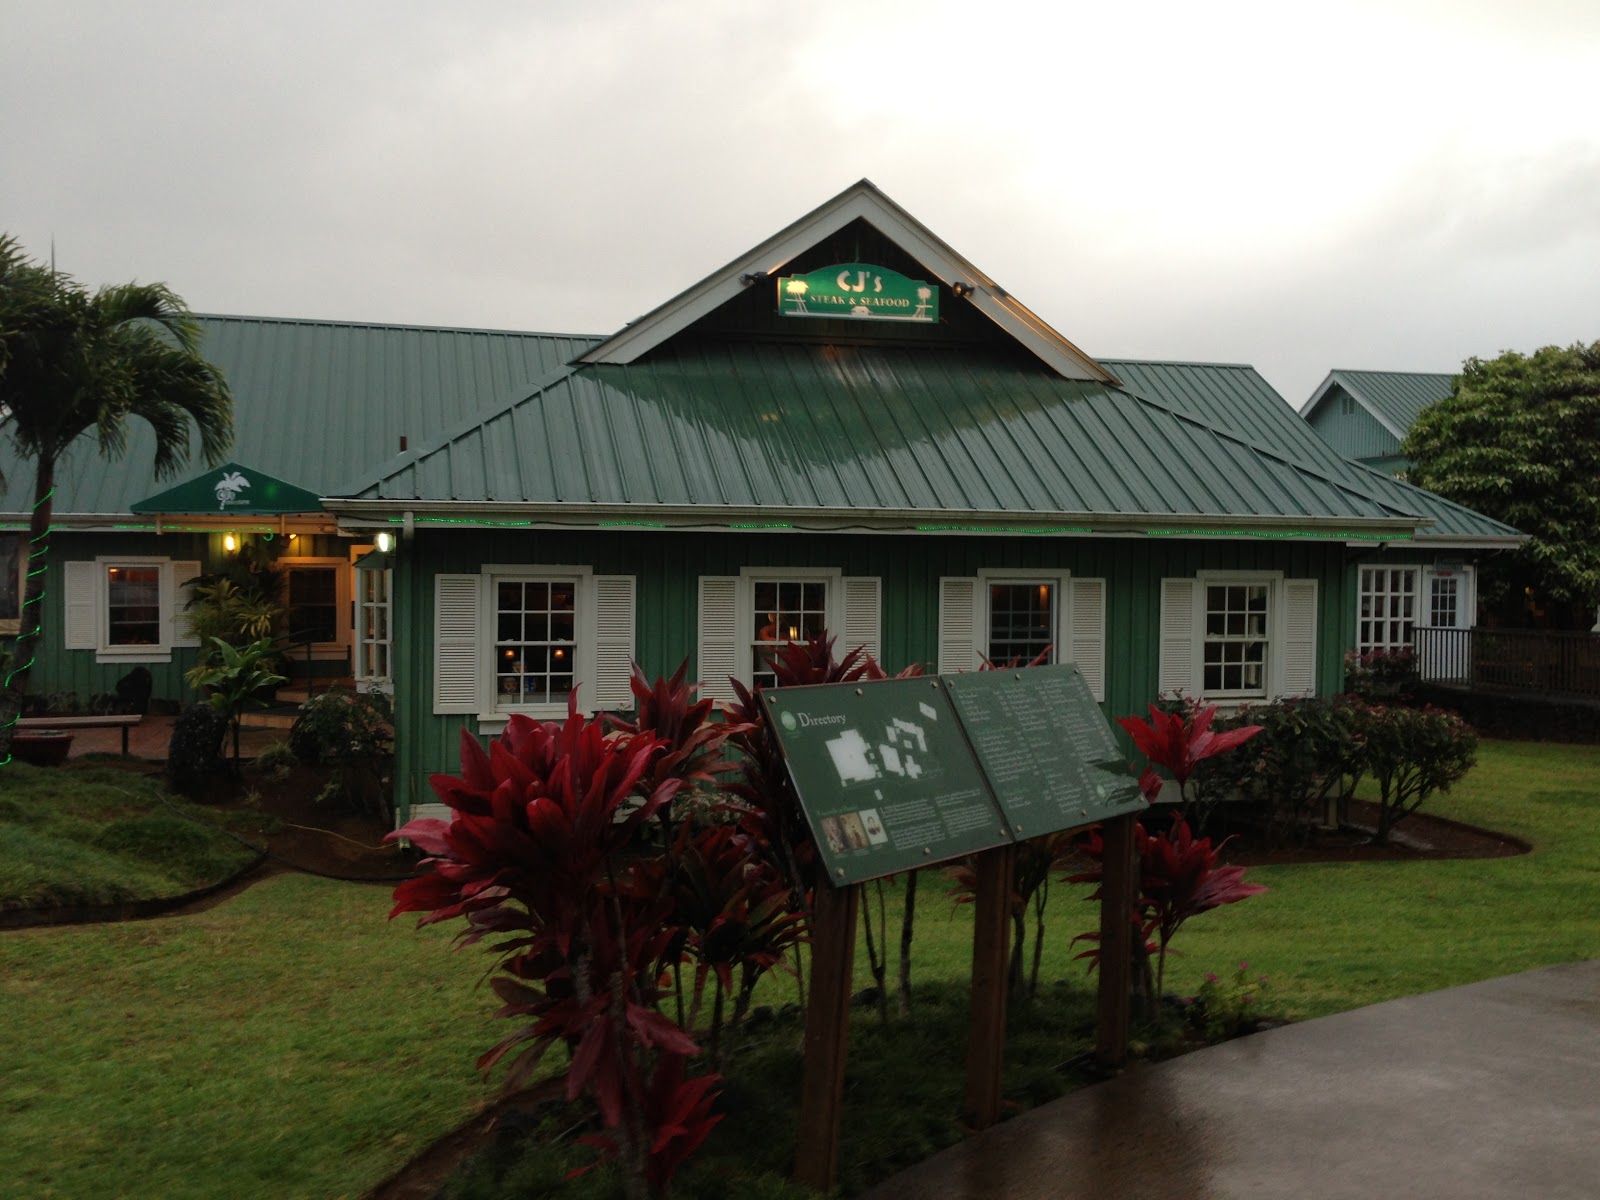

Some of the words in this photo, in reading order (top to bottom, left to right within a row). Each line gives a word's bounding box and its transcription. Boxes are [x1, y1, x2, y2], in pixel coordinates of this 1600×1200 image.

[836, 270, 883, 293] CJ's
[810, 295, 846, 305] STEAK
[849, 297, 857, 305] &
[860, 296, 910, 308] SEAFOOD
[797, 712, 846, 727] Directory
